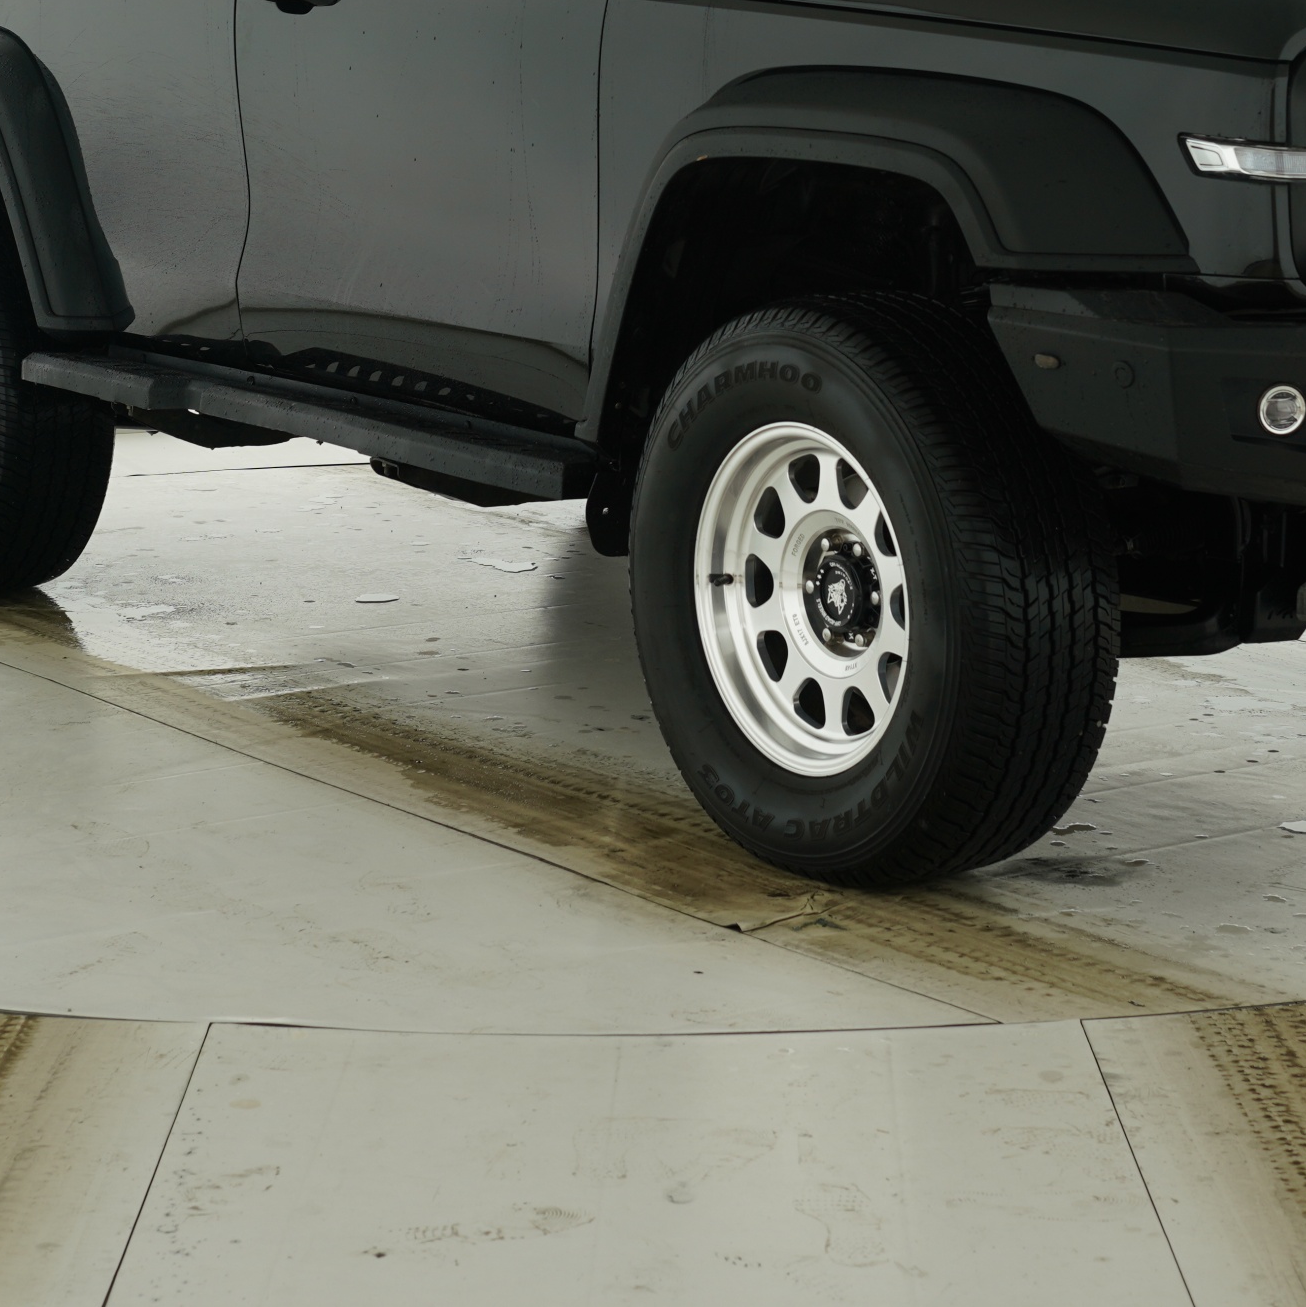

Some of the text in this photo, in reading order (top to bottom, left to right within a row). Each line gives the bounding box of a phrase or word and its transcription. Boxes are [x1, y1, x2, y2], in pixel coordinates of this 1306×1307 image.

[667, 359, 823, 451] CHARMHOO
[791, 533, 805, 557] FORGED
[784, 708, 924, 841] WILDTRAC
